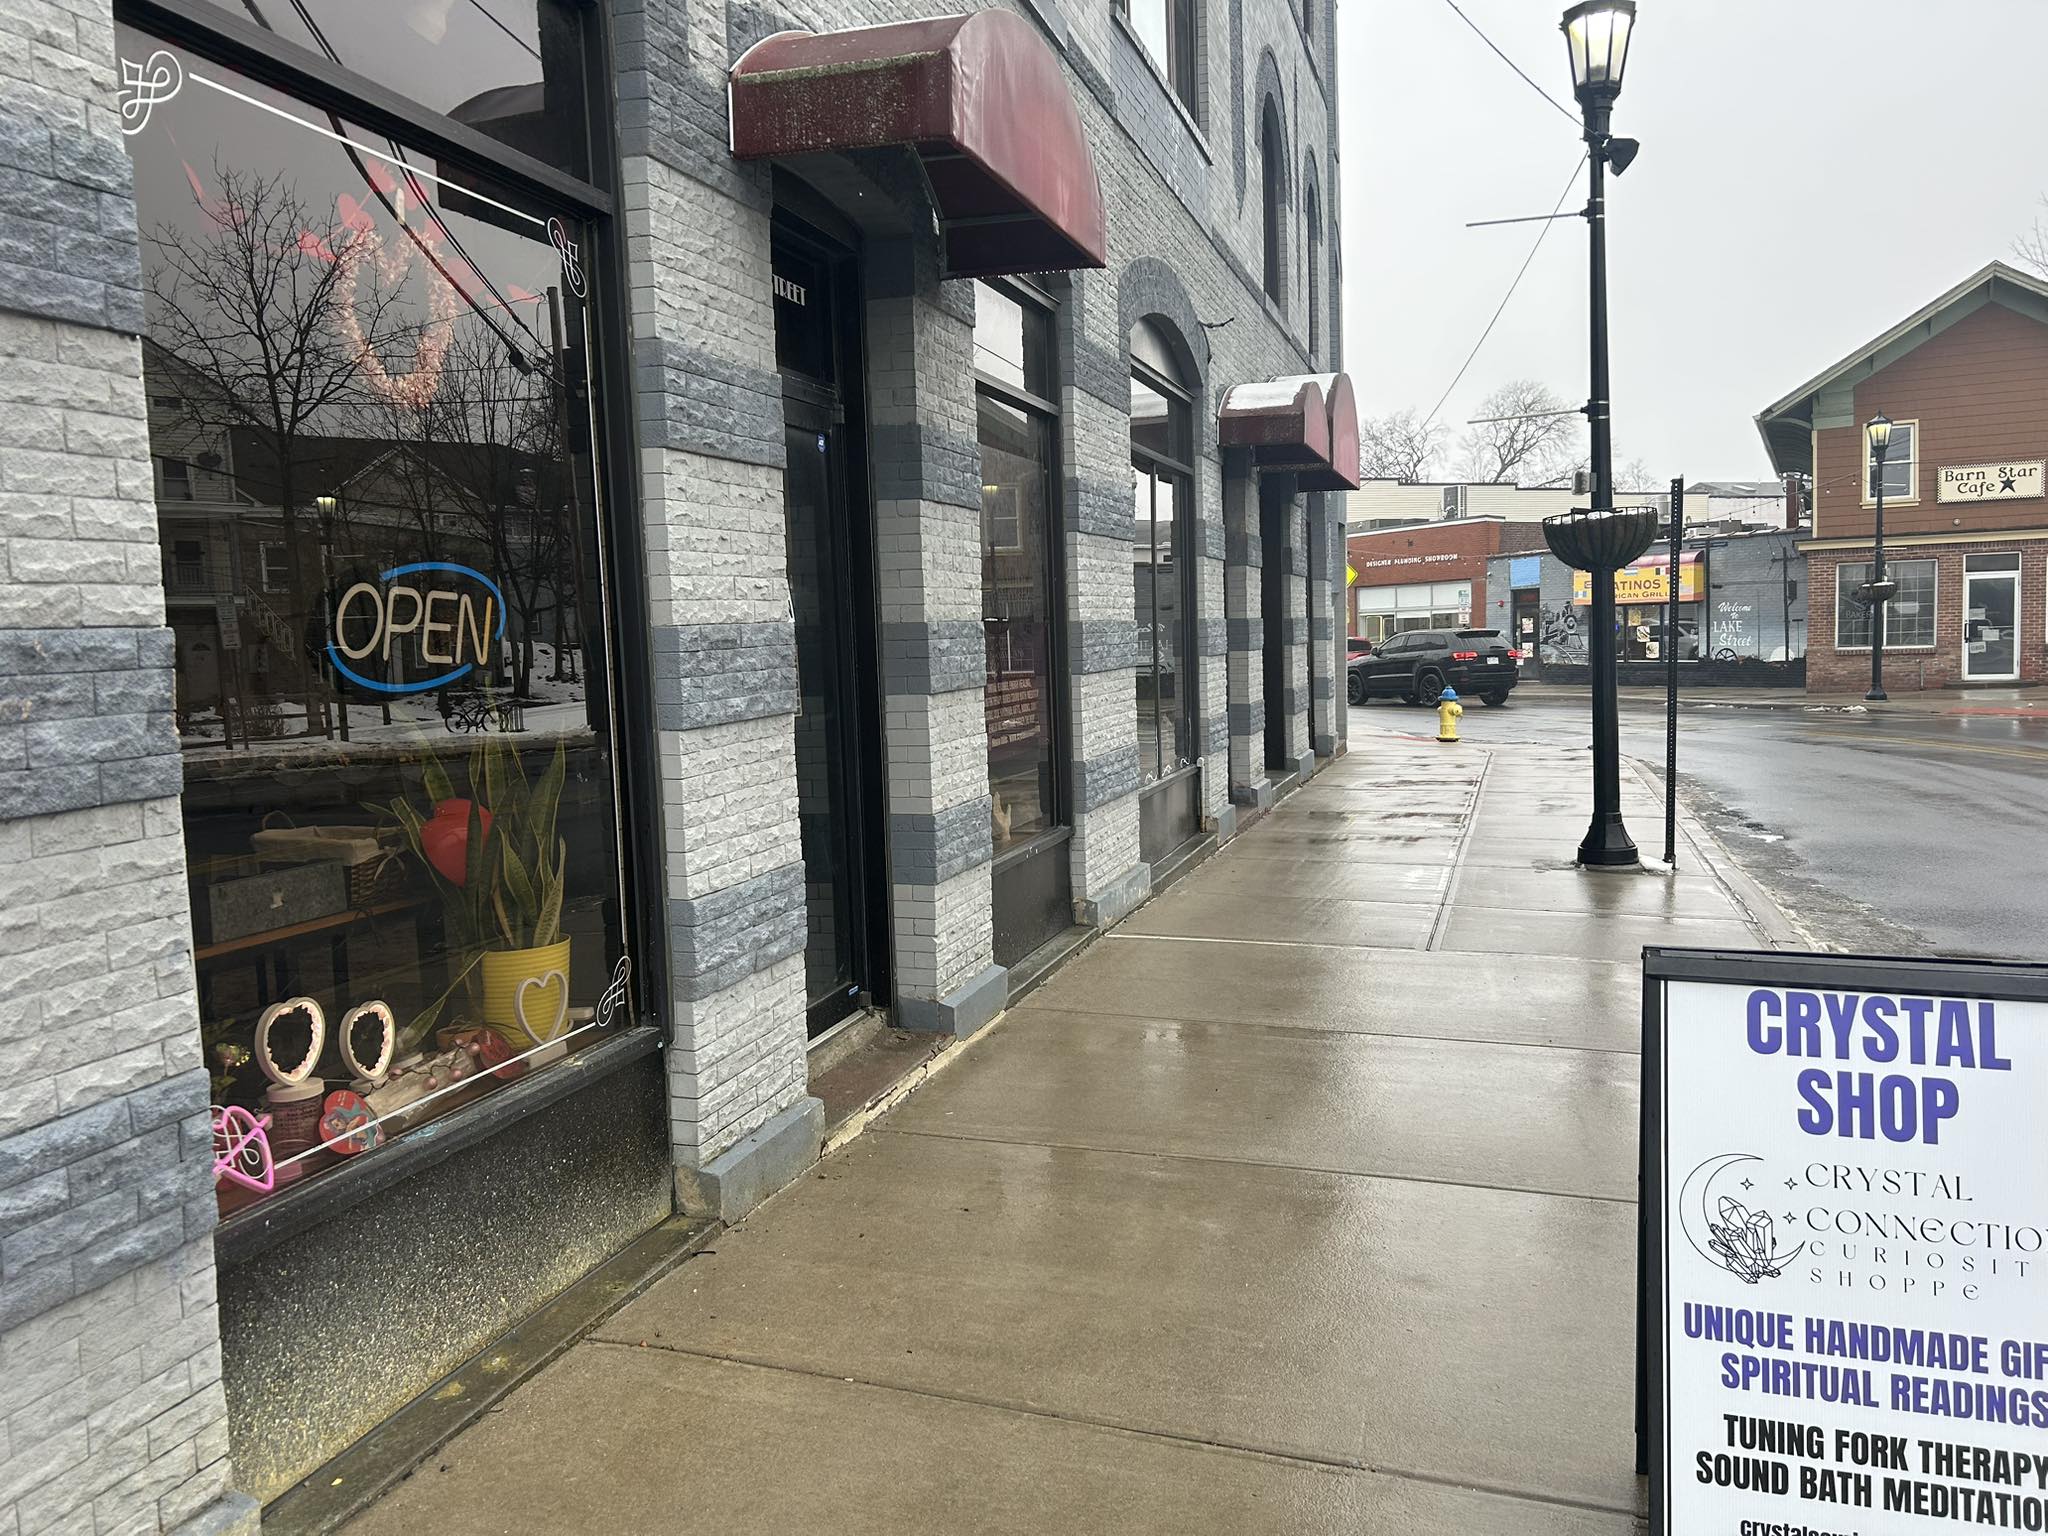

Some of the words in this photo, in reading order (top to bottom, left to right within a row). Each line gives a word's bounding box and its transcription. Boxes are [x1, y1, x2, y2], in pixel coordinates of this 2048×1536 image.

[772, 273, 806, 306] TREET
[1944, 470, 1986, 482] Barn
[1998, 466, 2037, 478] Star
[1957, 481, 1995, 497] Cafe
[1614, 579, 1661, 591] ATINOS
[336, 582, 492, 665] OPEN
[1713, 621, 1742, 632] LAKE
[1719, 633, 1751, 646] Street
[1746, 989, 2011, 1071] CRYSTAL
[1797, 1068, 1959, 1145] SHOP
[1805, 1163, 1973, 1201] CRYSTAL
[1806, 1207, 2048, 1252] CONNECTIO
[1810, 1240, 2029, 1277] CURIOSIT
[1810, 1268, 1979, 1300] SHOPPE
[1684, 1302, 1793, 1350] UNIQUE
[1805, 1317, 1989, 1374] HANDMADE
[2001, 1340, 2048, 1380] GIF
[1721, 1352, 1879, 1408] SPIRITUAL
[1891, 1373, 2048, 1429] READINGS
[1723, 1414, 1824, 1459] TUNING
[1835, 1429, 1908, 1471] FORK
[1918, 1440, 2048, 1490] THERAPY
[1696, 1451, 1789, 1495] SOUND
[1800, 1465, 1872, 1508] BATH
[1883, 1477, 2048, 1533] MEDITATIO
